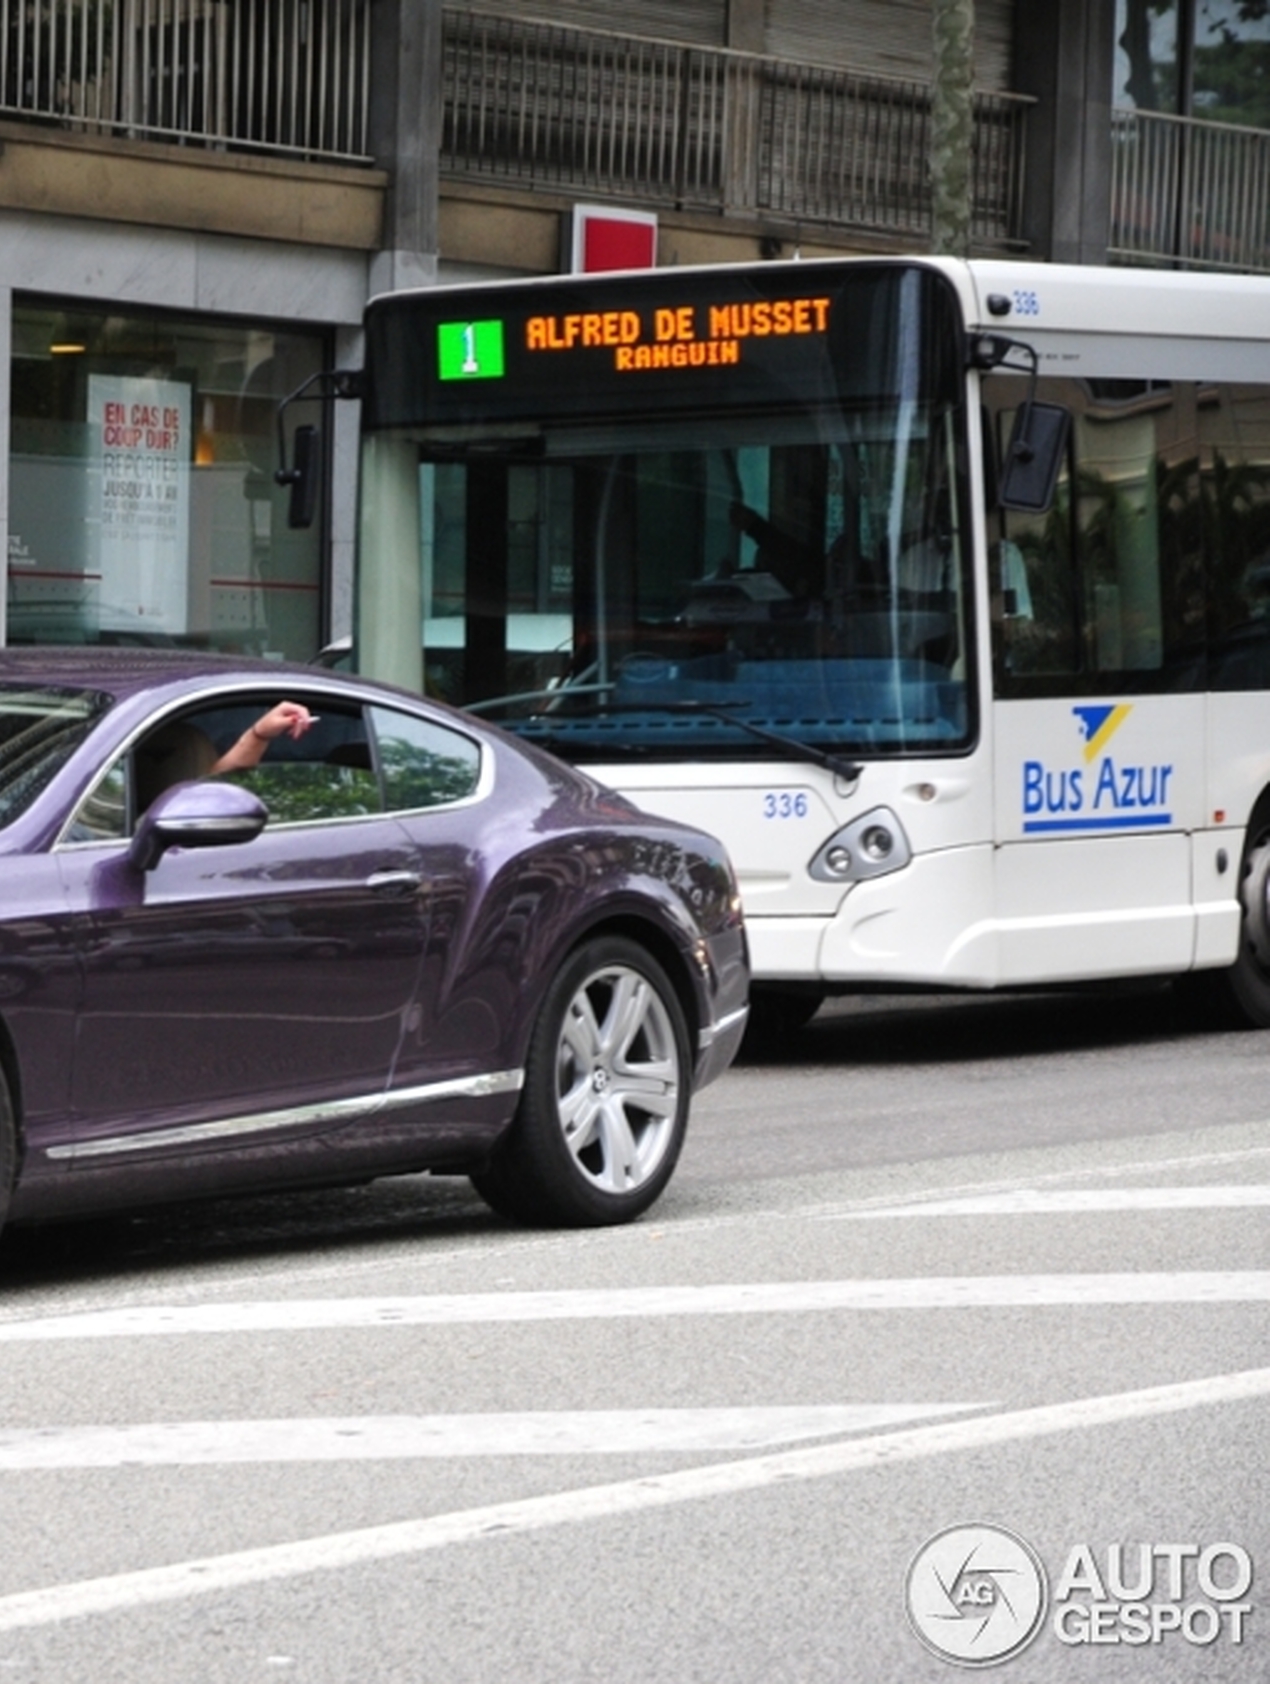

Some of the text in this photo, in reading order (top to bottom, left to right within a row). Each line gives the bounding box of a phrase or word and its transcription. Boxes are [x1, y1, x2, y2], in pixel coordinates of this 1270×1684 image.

[1013, 291, 1039, 315] 336
[527, 299, 830, 349] ALFRED DE MUSSET
[462, 324, 478, 372] 1
[104, 402, 179, 430] EN CAS DE
[104, 426, 179, 451] COUP DUR?
[1024, 757, 1173, 815] Bus Azur
[763, 793, 807, 818] 336
